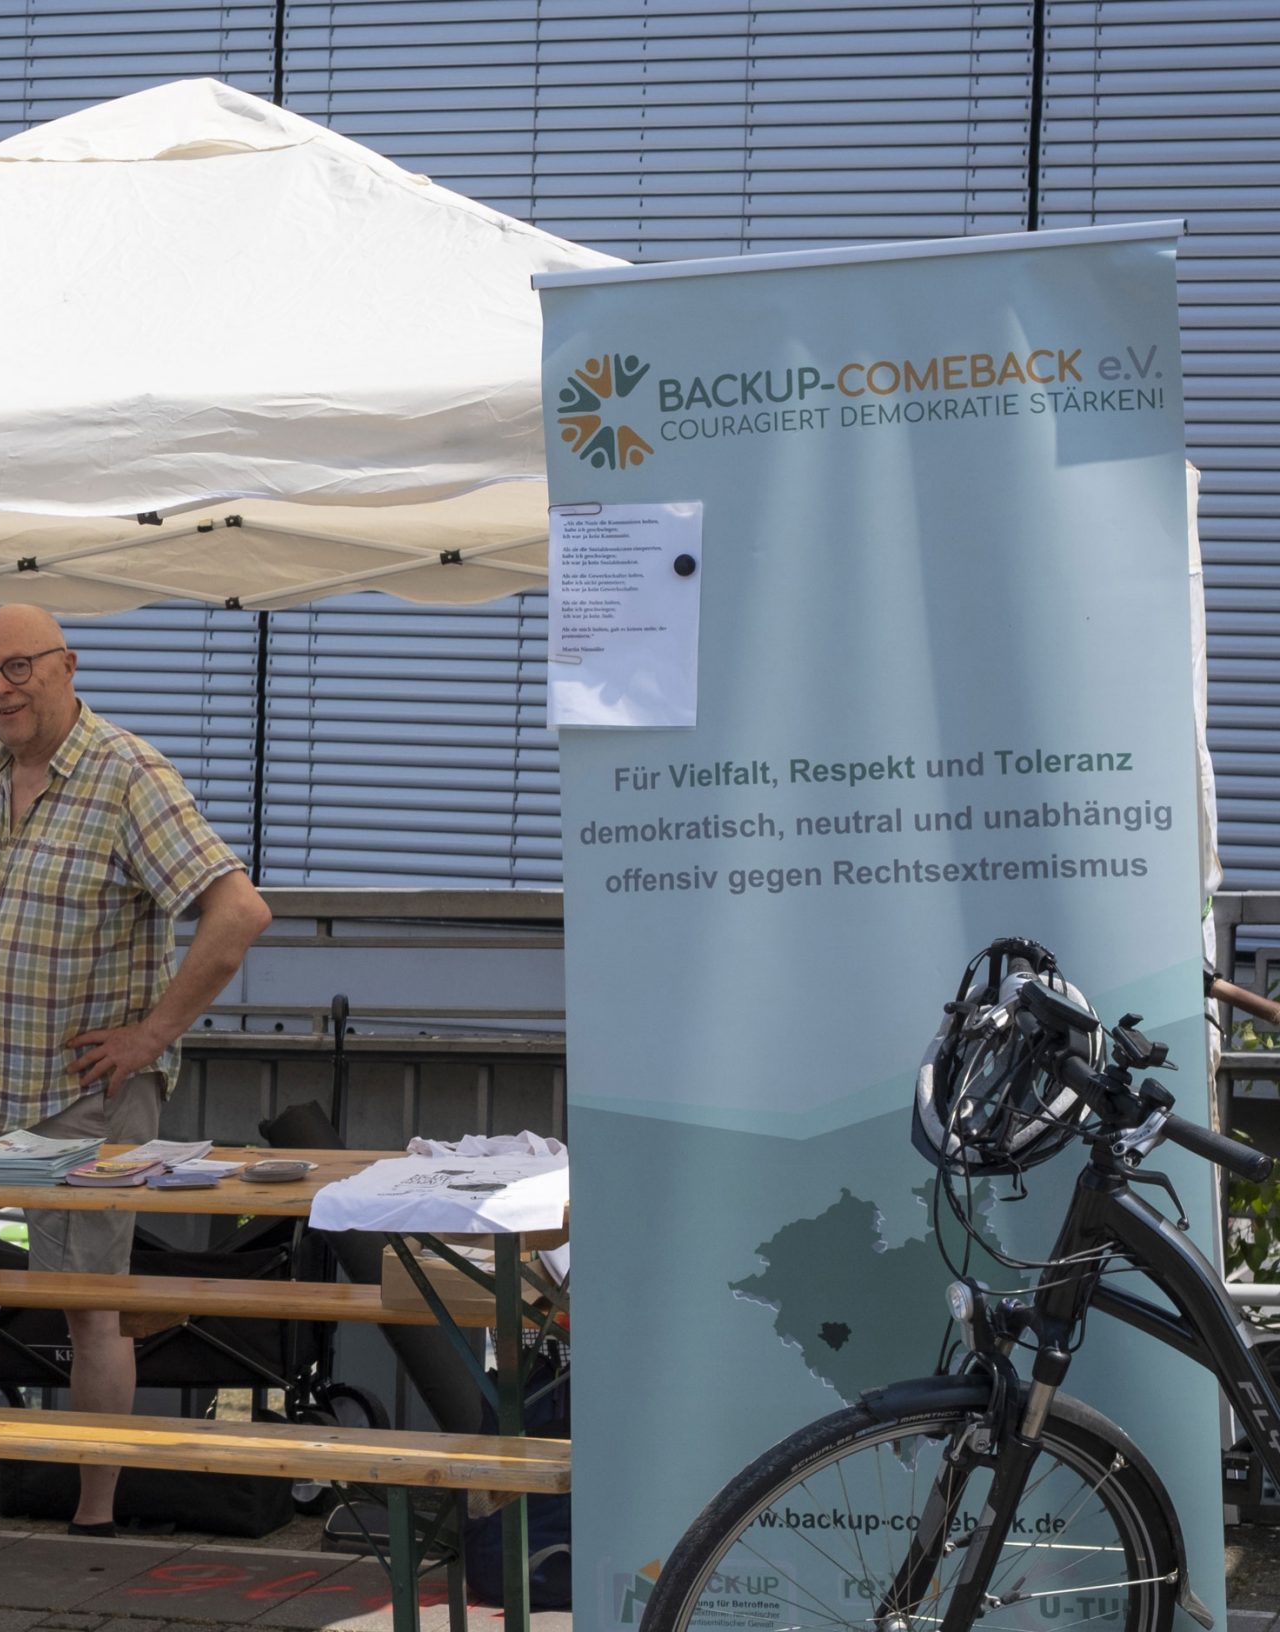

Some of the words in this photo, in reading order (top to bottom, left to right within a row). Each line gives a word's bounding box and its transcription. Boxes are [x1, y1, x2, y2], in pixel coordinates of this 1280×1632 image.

[659, 349, 1082, 412] BACKUP-COMEBACK
[1098, 345, 1162, 381] e.V.
[661, 408, 830, 441] COURAGIERT
[841, 394, 1019, 427] DEMOKRATIE
[1030, 387, 1164, 414] STÄRKEN!
[615, 767, 660, 791] Für
[669, 761, 778, 788] Vielfalt,
[790, 756, 915, 787] Respekt
[927, 752, 984, 778] und
[995, 749, 1133, 775] Toleranz
[580, 813, 784, 845] demokratisch,
[796, 808, 901, 836] neutral
[914, 805, 972, 831] und
[984, 800, 1172, 831] unabhängig
[606, 866, 718, 893] offensiv
[729, 867, 821, 894] gegen
[833, 854, 1148, 885] Rechtsextremismus
